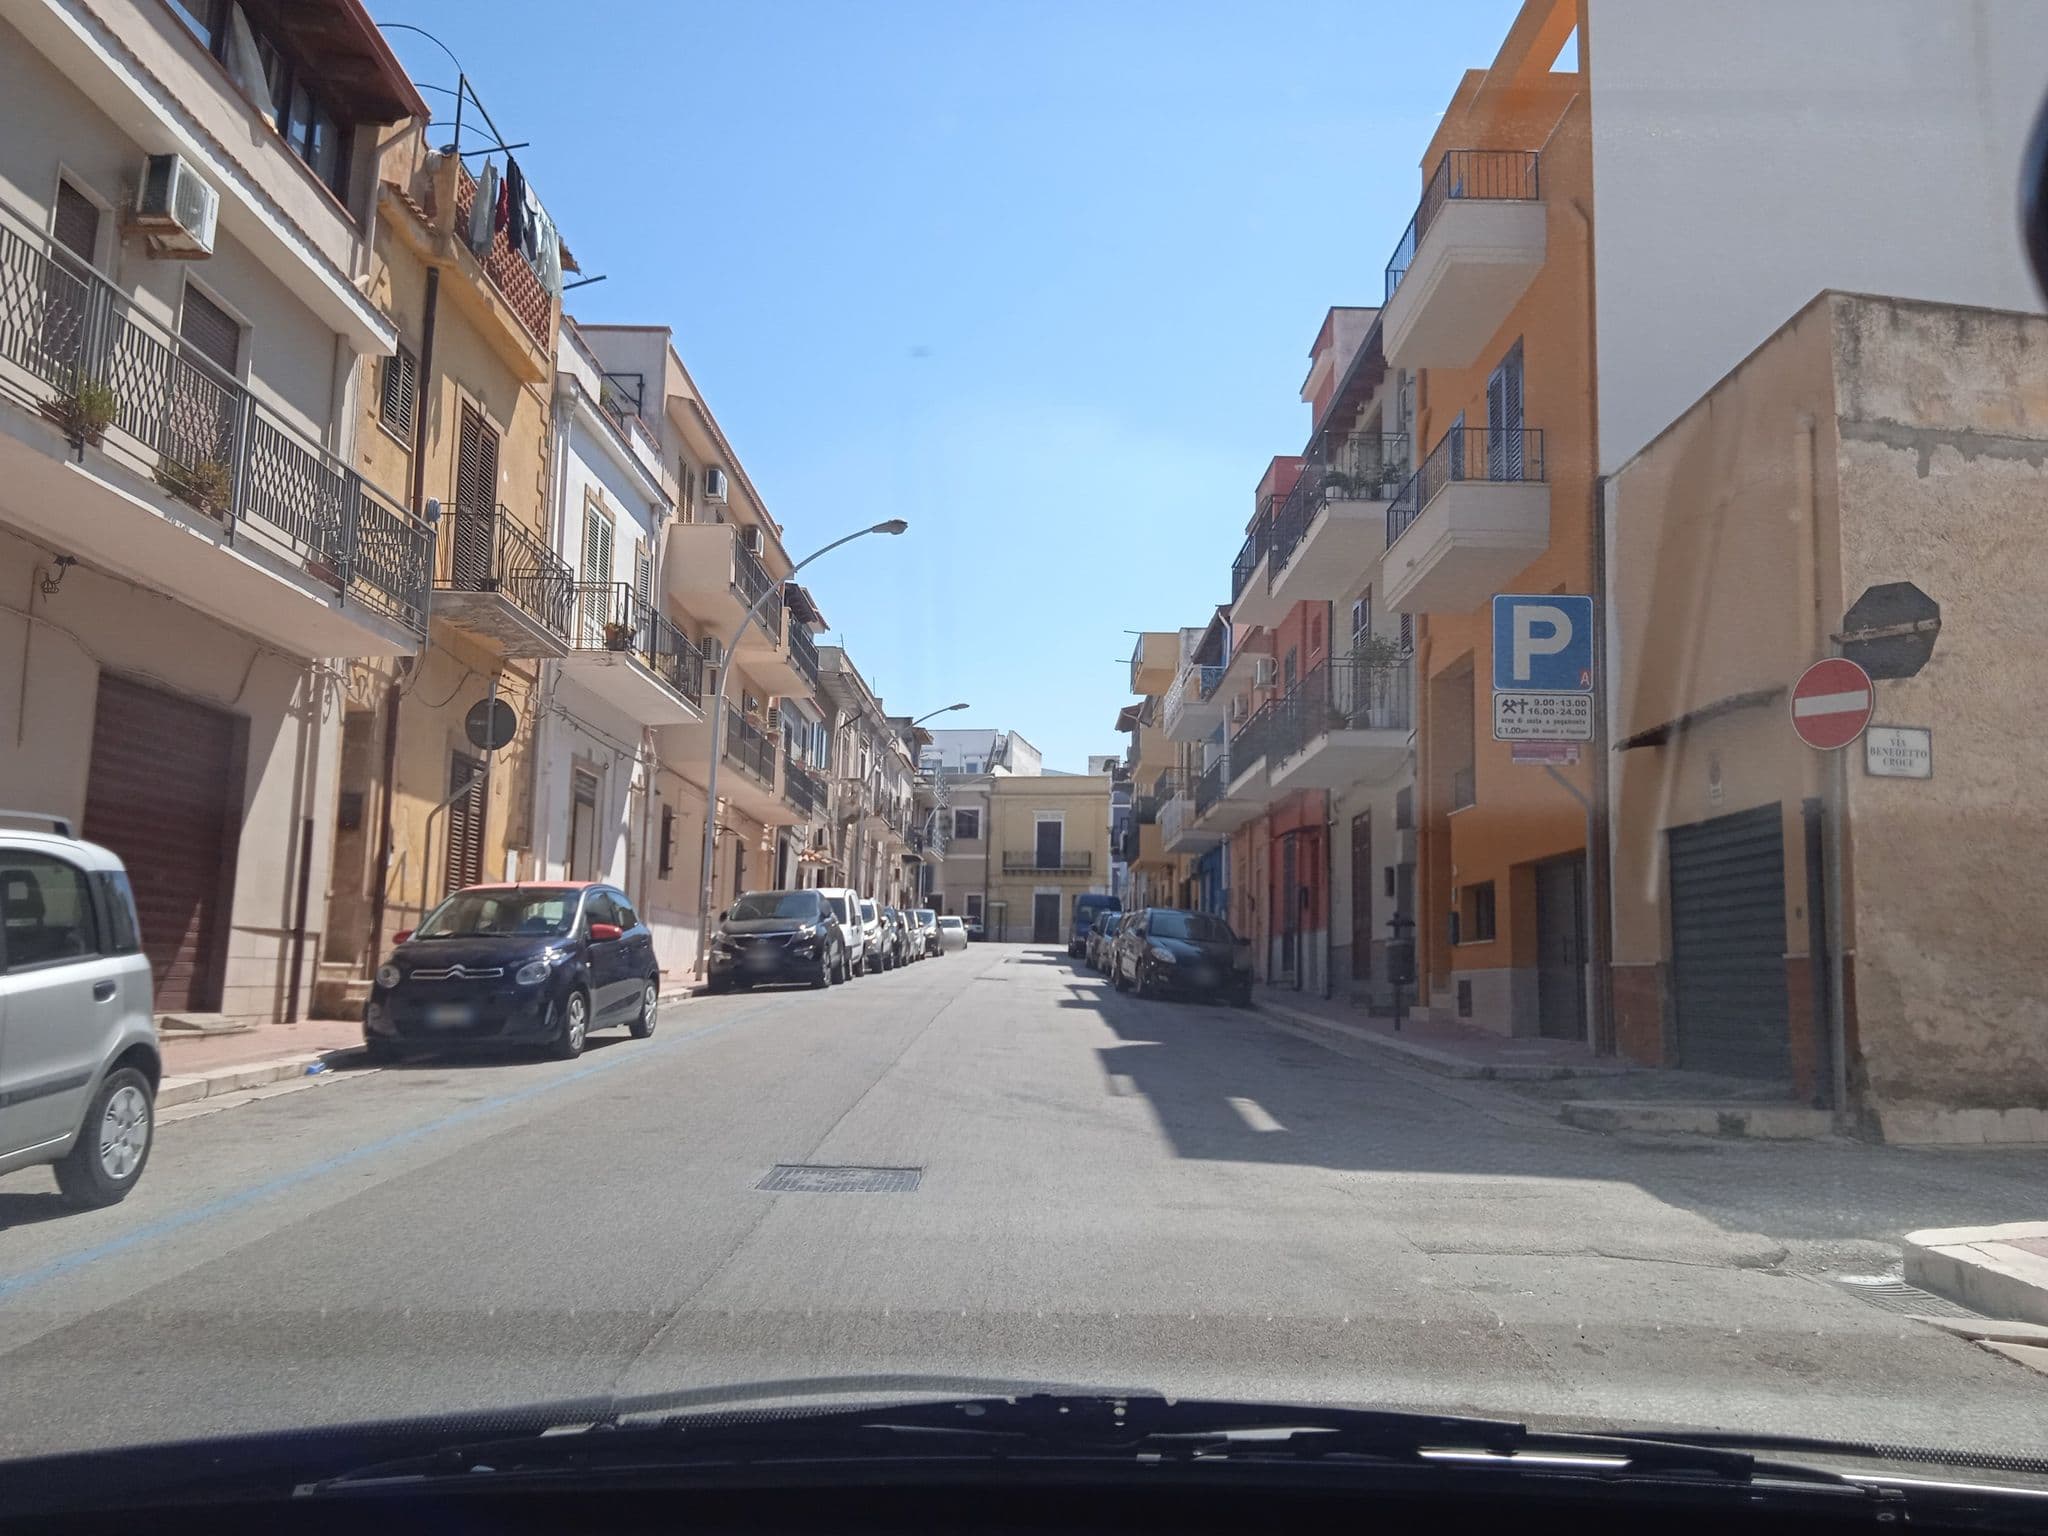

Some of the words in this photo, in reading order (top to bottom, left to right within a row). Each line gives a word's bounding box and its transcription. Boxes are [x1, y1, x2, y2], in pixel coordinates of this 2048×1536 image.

[1513, 605, 1573, 681] P
[1889, 738, 1906, 747] VIA
[1870, 746, 1928, 759] BENEDETTO
[1882, 758, 1913, 768] CROCE
